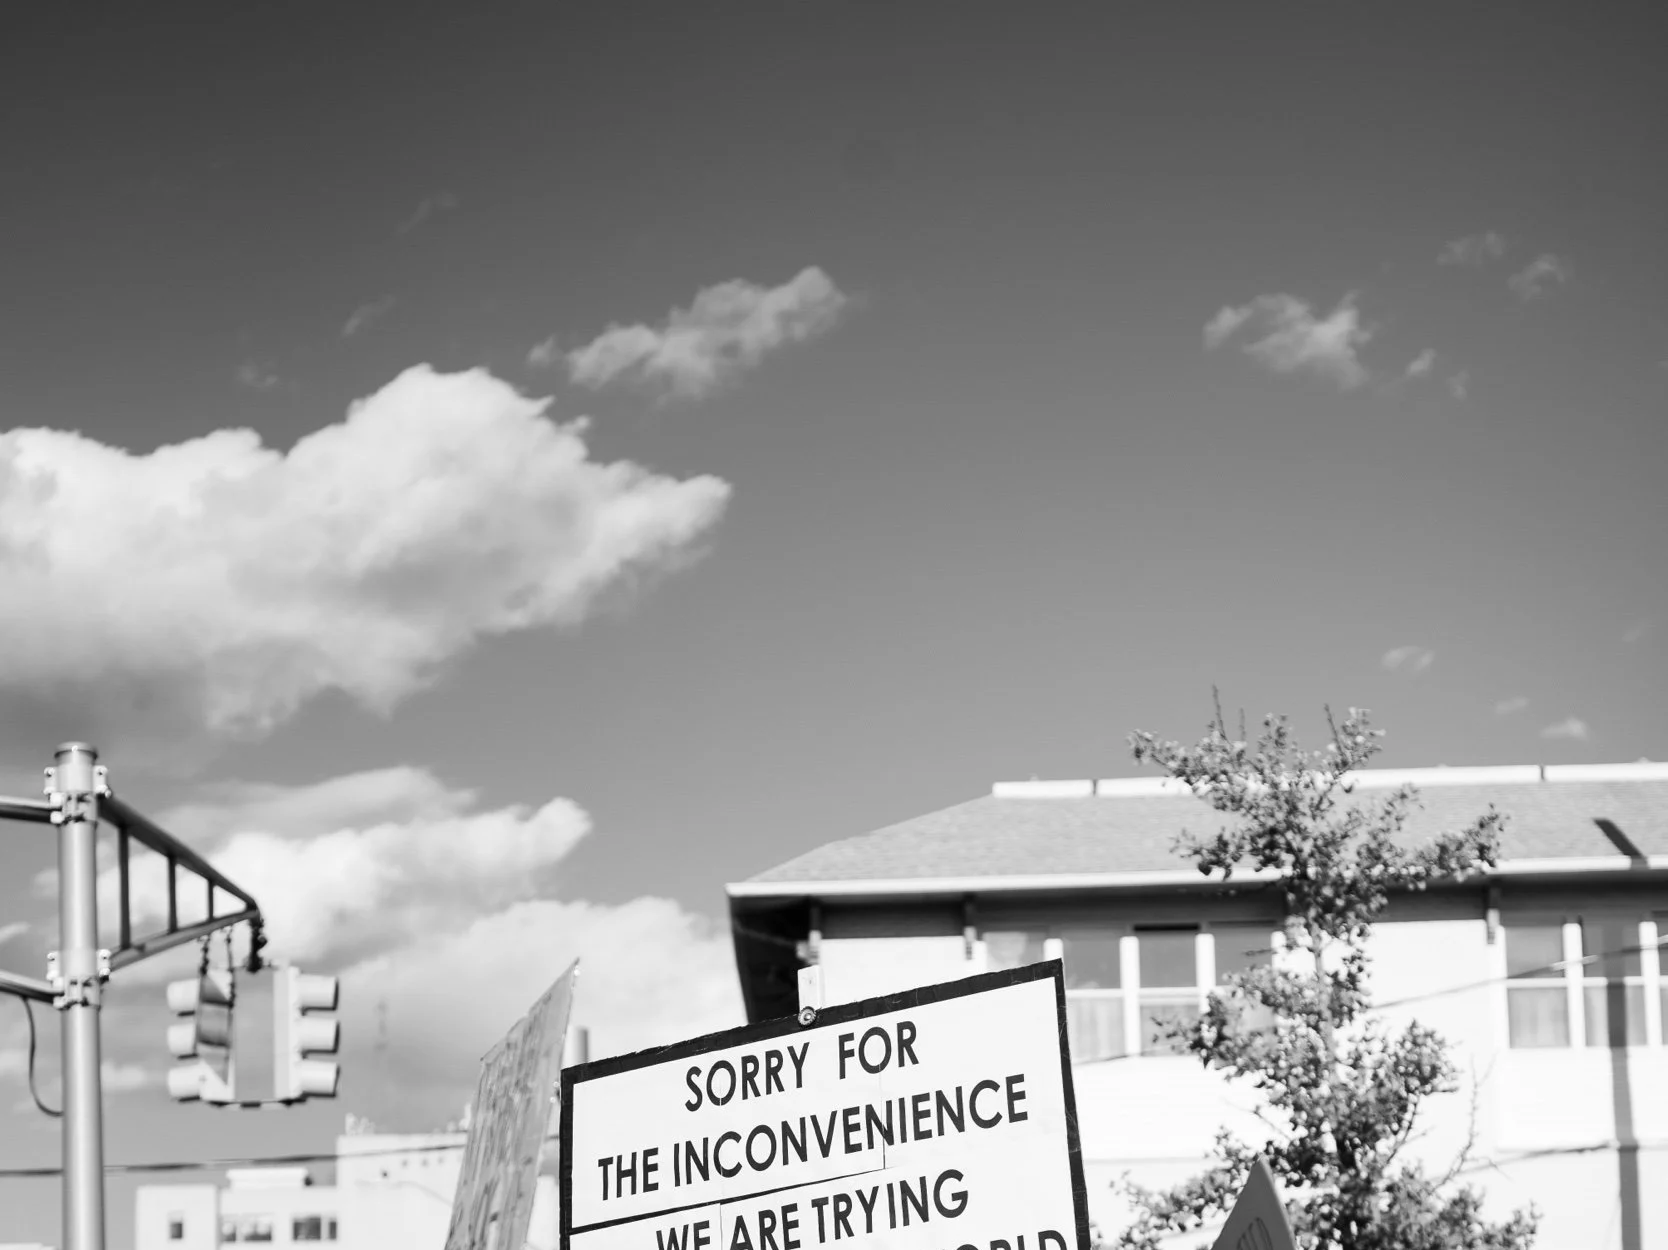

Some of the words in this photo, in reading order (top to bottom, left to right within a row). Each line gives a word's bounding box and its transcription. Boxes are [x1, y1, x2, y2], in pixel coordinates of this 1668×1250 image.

[685, 1042, 810, 1112] SORRY
[838, 1020, 919, 1080] FOR
[598, 1147, 659, 1201] THE
[673, 1074, 1028, 1188] INCONVENIENCE
[811, 1169, 969, 1244] TRYING
